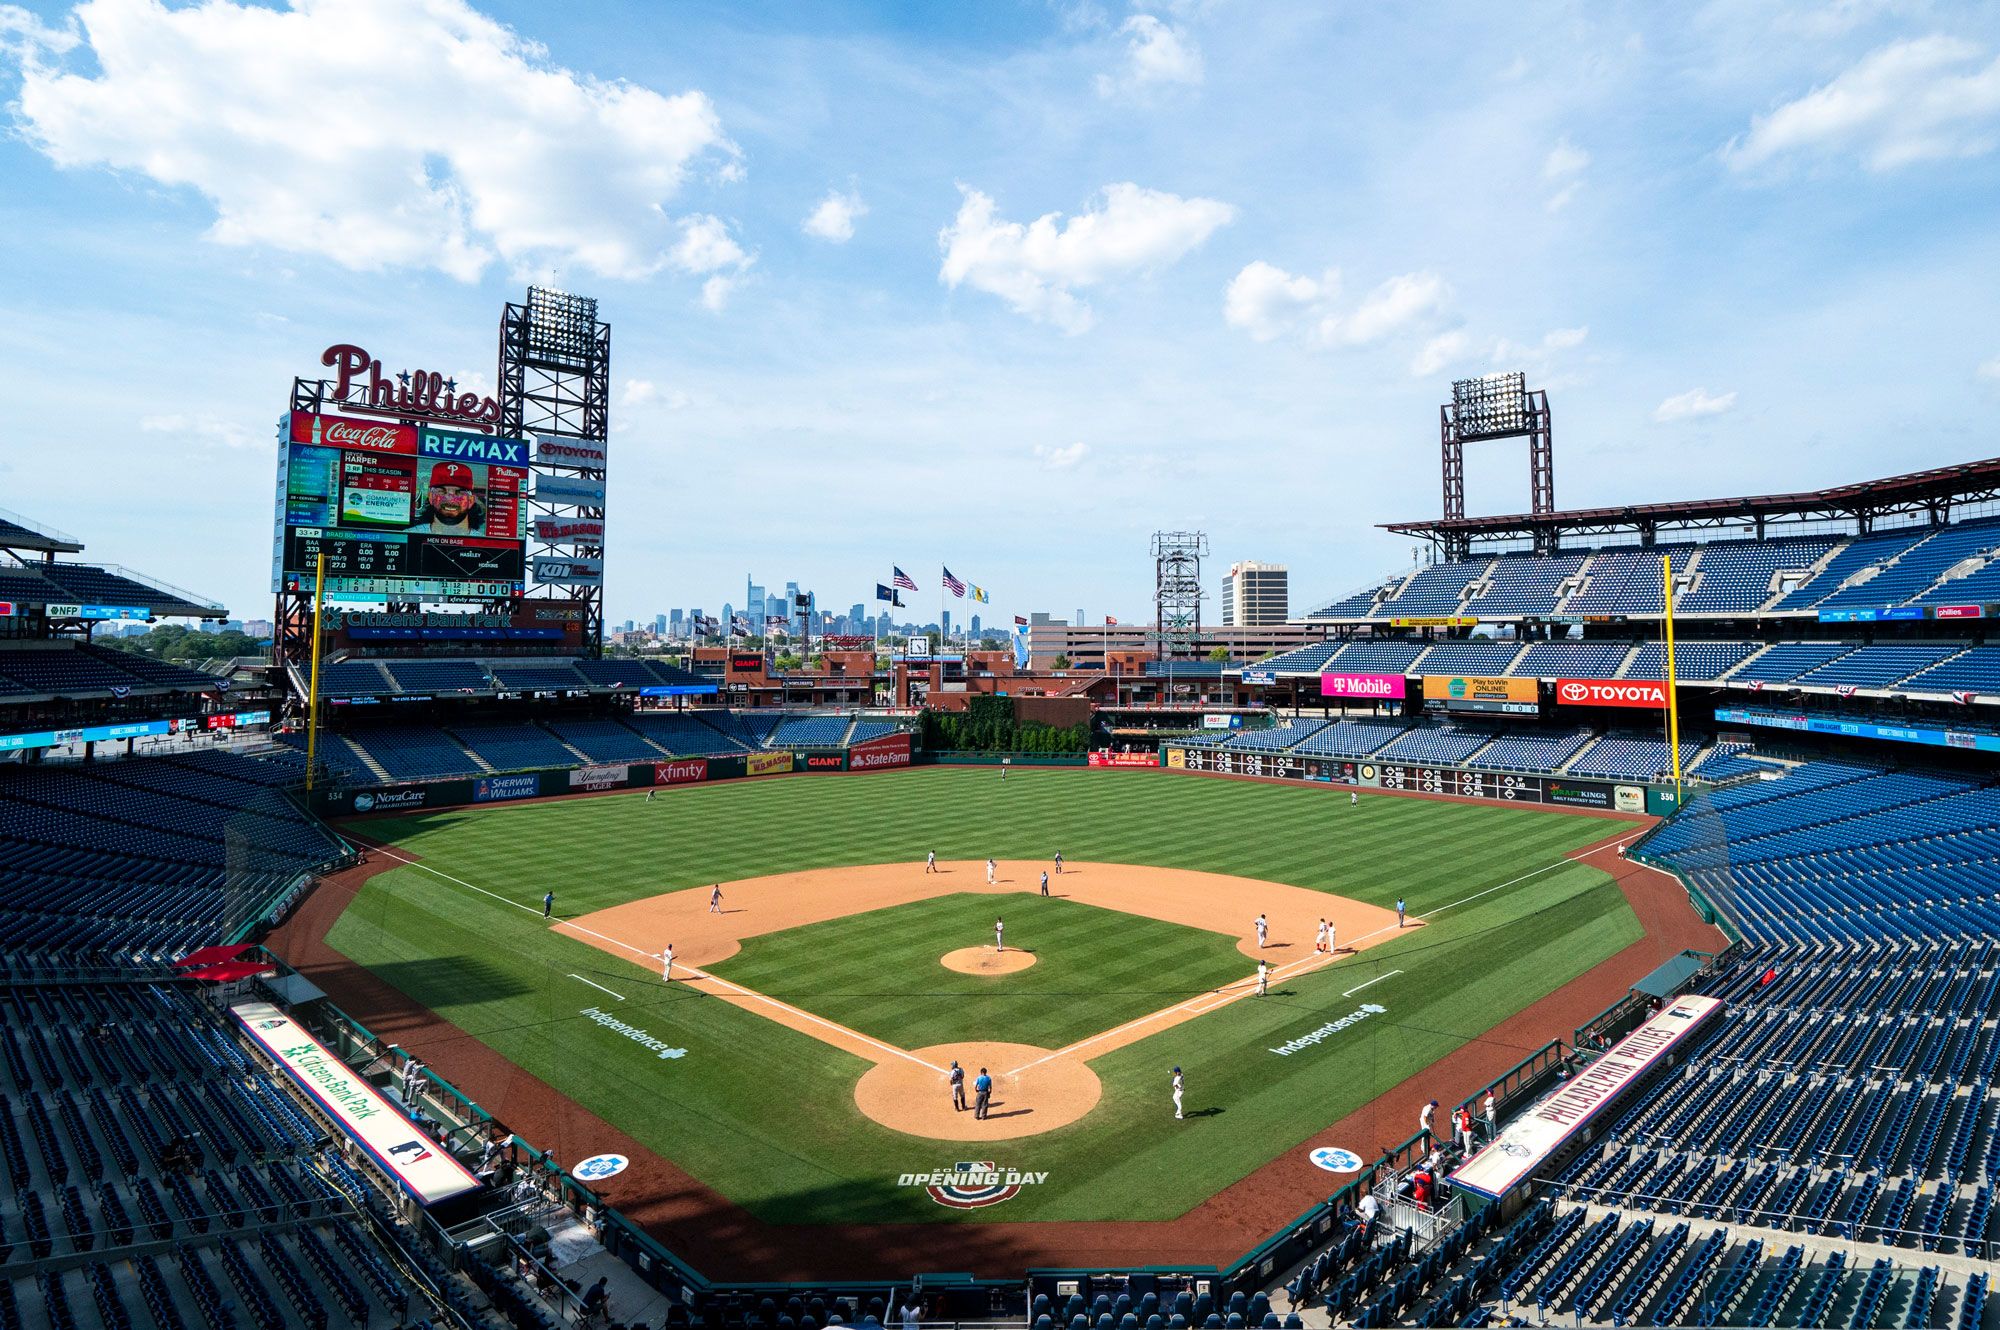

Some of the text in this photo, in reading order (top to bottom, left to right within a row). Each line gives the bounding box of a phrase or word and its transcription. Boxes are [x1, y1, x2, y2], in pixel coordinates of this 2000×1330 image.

[321, 344, 501, 423] Phillies
[326, 422, 400, 448] Coca-Cola
[425, 434, 518, 462] RE/MAX
[556, 446, 604, 460] TOYOTA
[345, 456, 377, 464] HARPER
[538, 564, 571, 578] KDI
[478, 585, 508, 594] 0 0 0
[347, 611, 512, 627] Citizens Bank Park
[1145, 632, 1214, 640] Citizens Bank
[1170, 642, 1191, 651] Park
[1590, 686, 1664, 701] TOYOTA
[578, 771, 620, 783] Yuengling
[659, 764, 704, 782] xfinity
[492, 778, 534, 788] SHERWIN
[586, 783, 612, 791] LAGER
[375, 791, 425, 803] NovaCare
[1551, 790, 1606, 799] DRAFTKINGS
[1661, 793, 1674, 801] 330
[580, 1006, 668, 1050] Independence
[1268, 1010, 1370, 1056] Independence
[1536, 1027, 1675, 1126] PHILADELPHIA PHILLIES
[298, 1055, 380, 1120] Citizens Bank Park
[898, 1172, 1049, 1186] OPENING DAY
